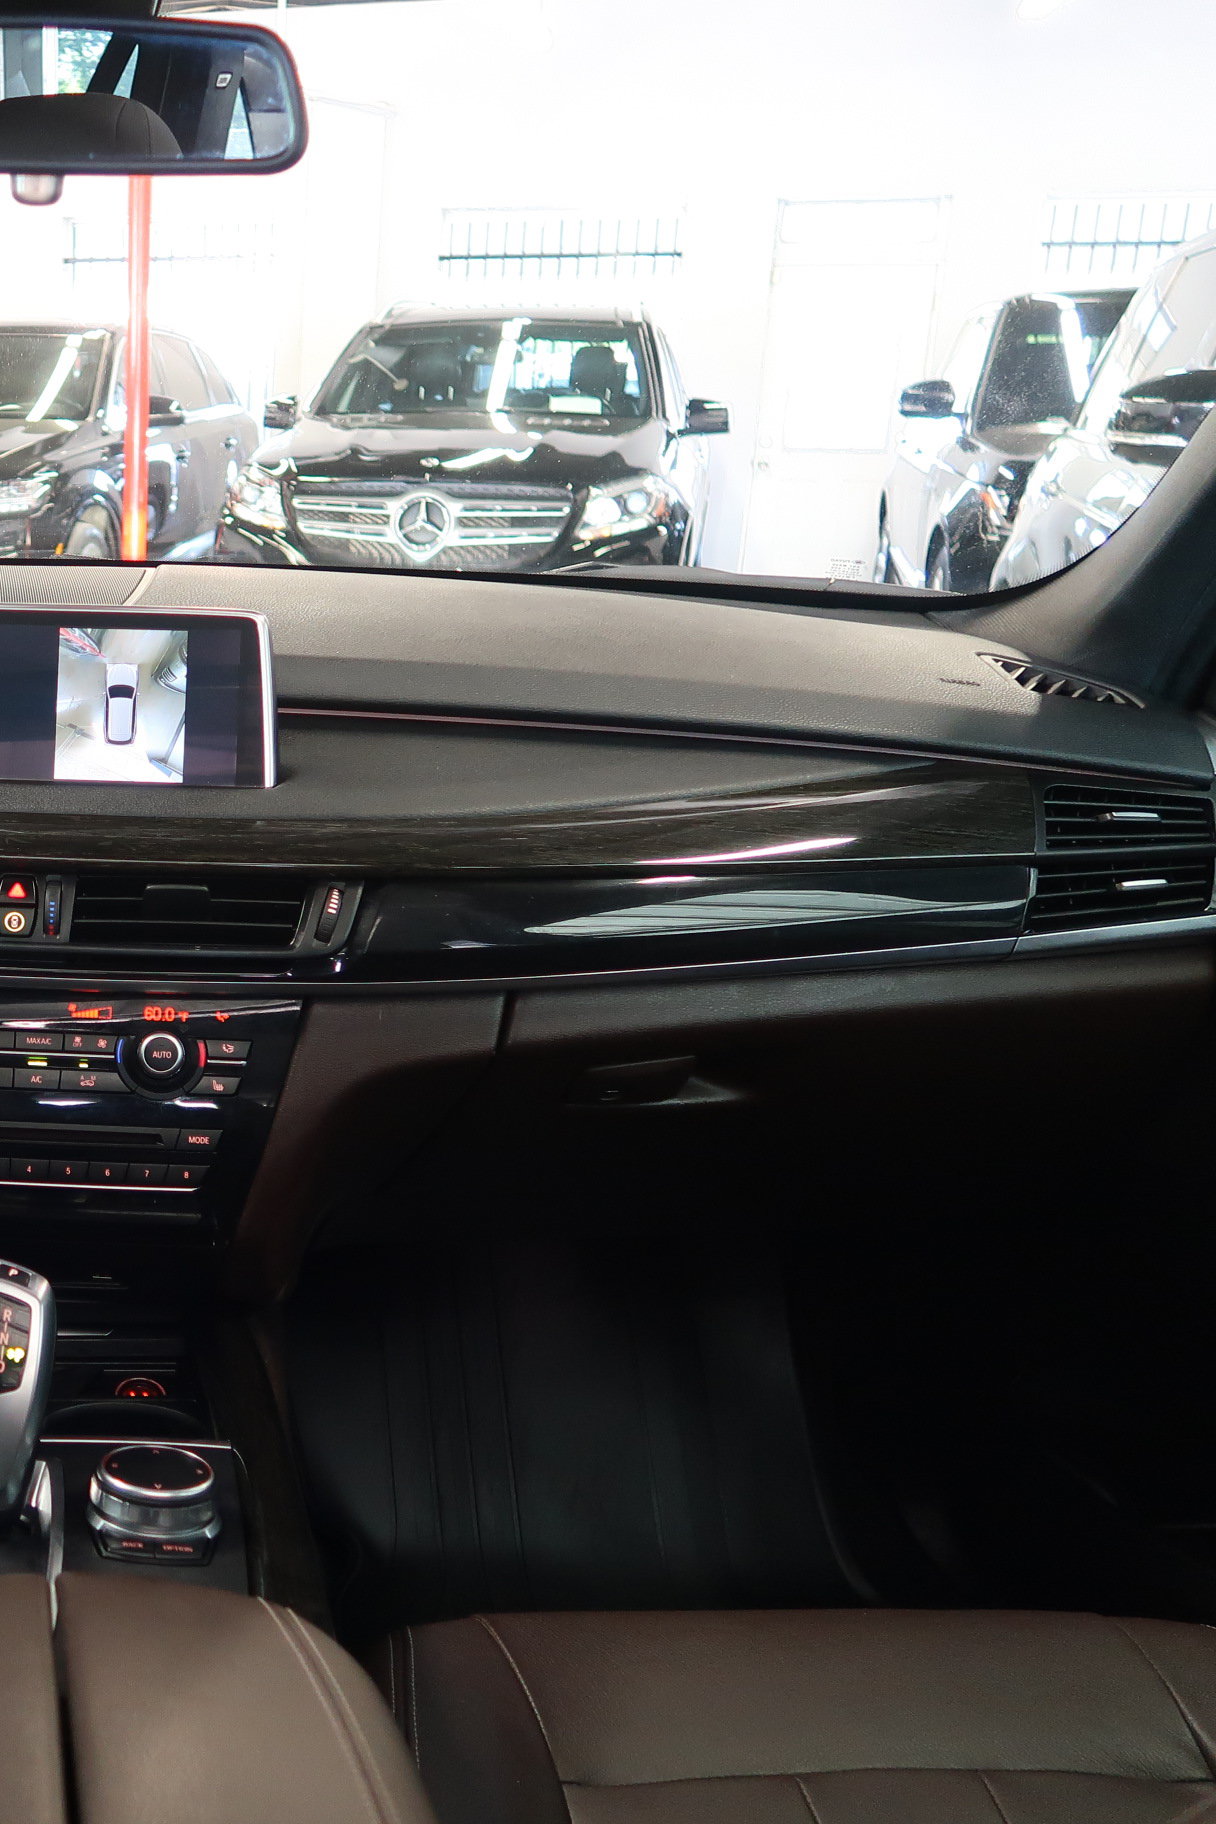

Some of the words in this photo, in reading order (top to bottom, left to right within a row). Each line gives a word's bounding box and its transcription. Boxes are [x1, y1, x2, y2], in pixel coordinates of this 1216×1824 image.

[143, 1006, 175, 1022] 60.0
[152, 1051, 172, 1060] AUTO
[31, 1075, 42, 1083] A/C
[188, 1136, 210, 1145] MODE
[26, 1165, 32, 1174] 4
[65, 1167, 71, 1175] 5
[104, 1168, 111, 1177] 6
[144, 1170, 150, 1178] 7
[183, 1171, 189, 1179] 8
[9, 1268, 18, 1276] P
[3, 1309, 12, 1321] R
[0, 1332, 9, 1345] N
